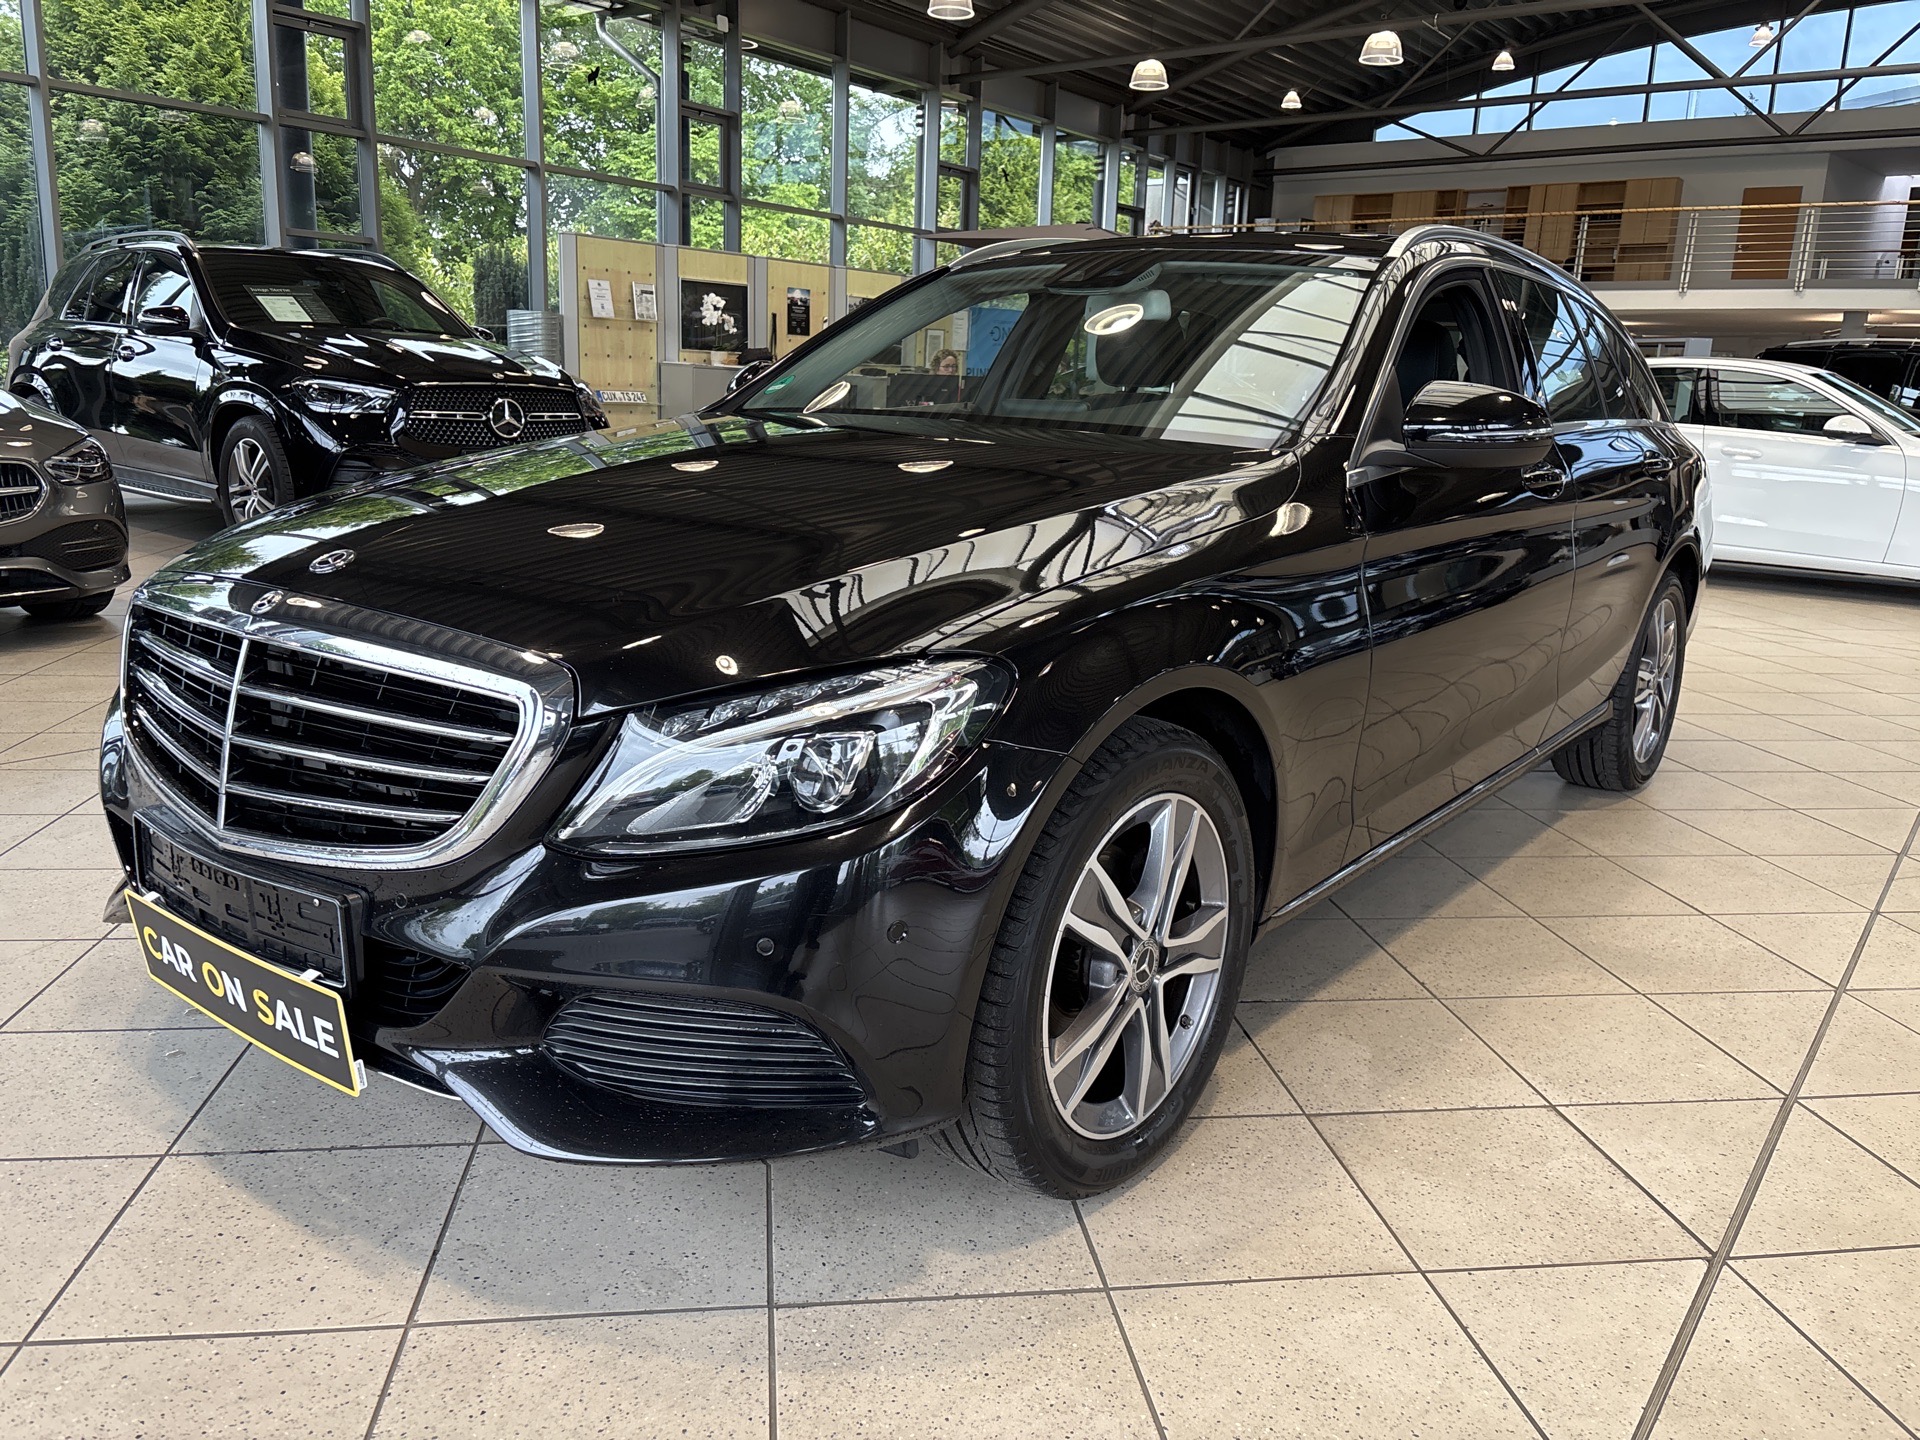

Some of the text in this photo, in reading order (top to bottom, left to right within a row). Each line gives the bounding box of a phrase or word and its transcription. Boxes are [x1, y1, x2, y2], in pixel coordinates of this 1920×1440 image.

[143, 926, 340, 1060] CAR ON SALE
